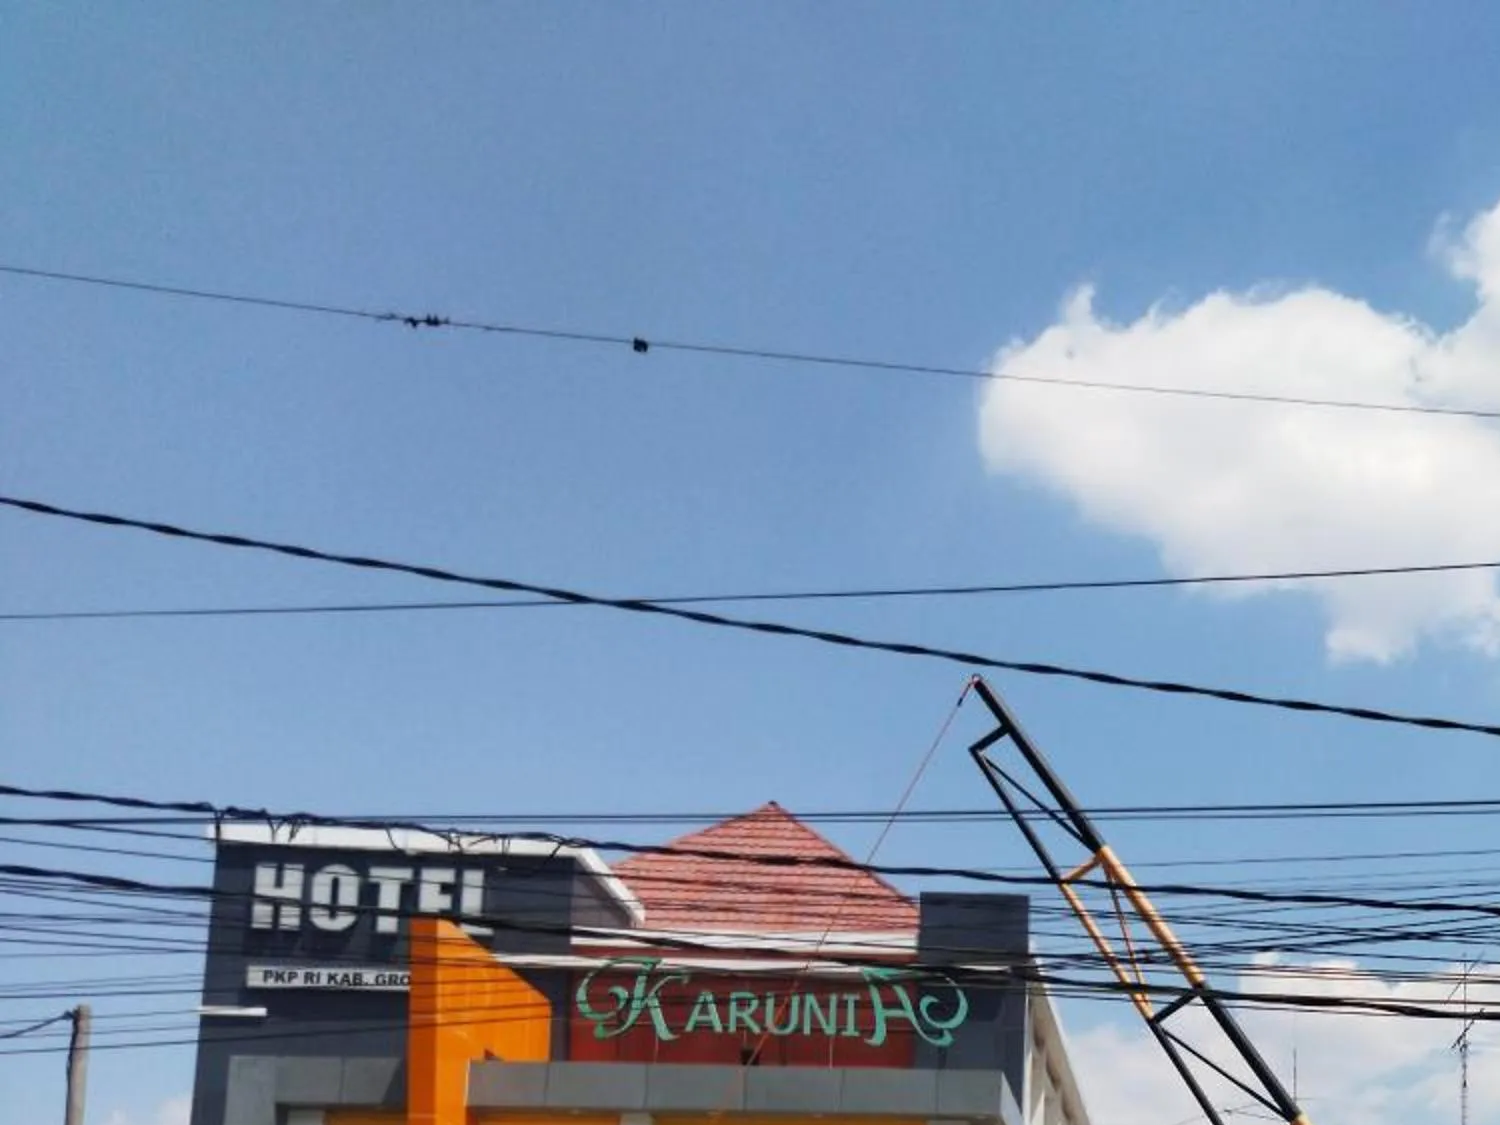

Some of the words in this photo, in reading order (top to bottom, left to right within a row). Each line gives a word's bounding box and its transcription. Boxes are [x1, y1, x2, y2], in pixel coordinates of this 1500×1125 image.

[251, 863, 495, 936] HOTEL
[263, 969, 299, 985] PKP
[304, 971, 321, 985] RI
[327, 972, 370, 987] KAB.
[575, 955, 969, 1047] KARUNIA
